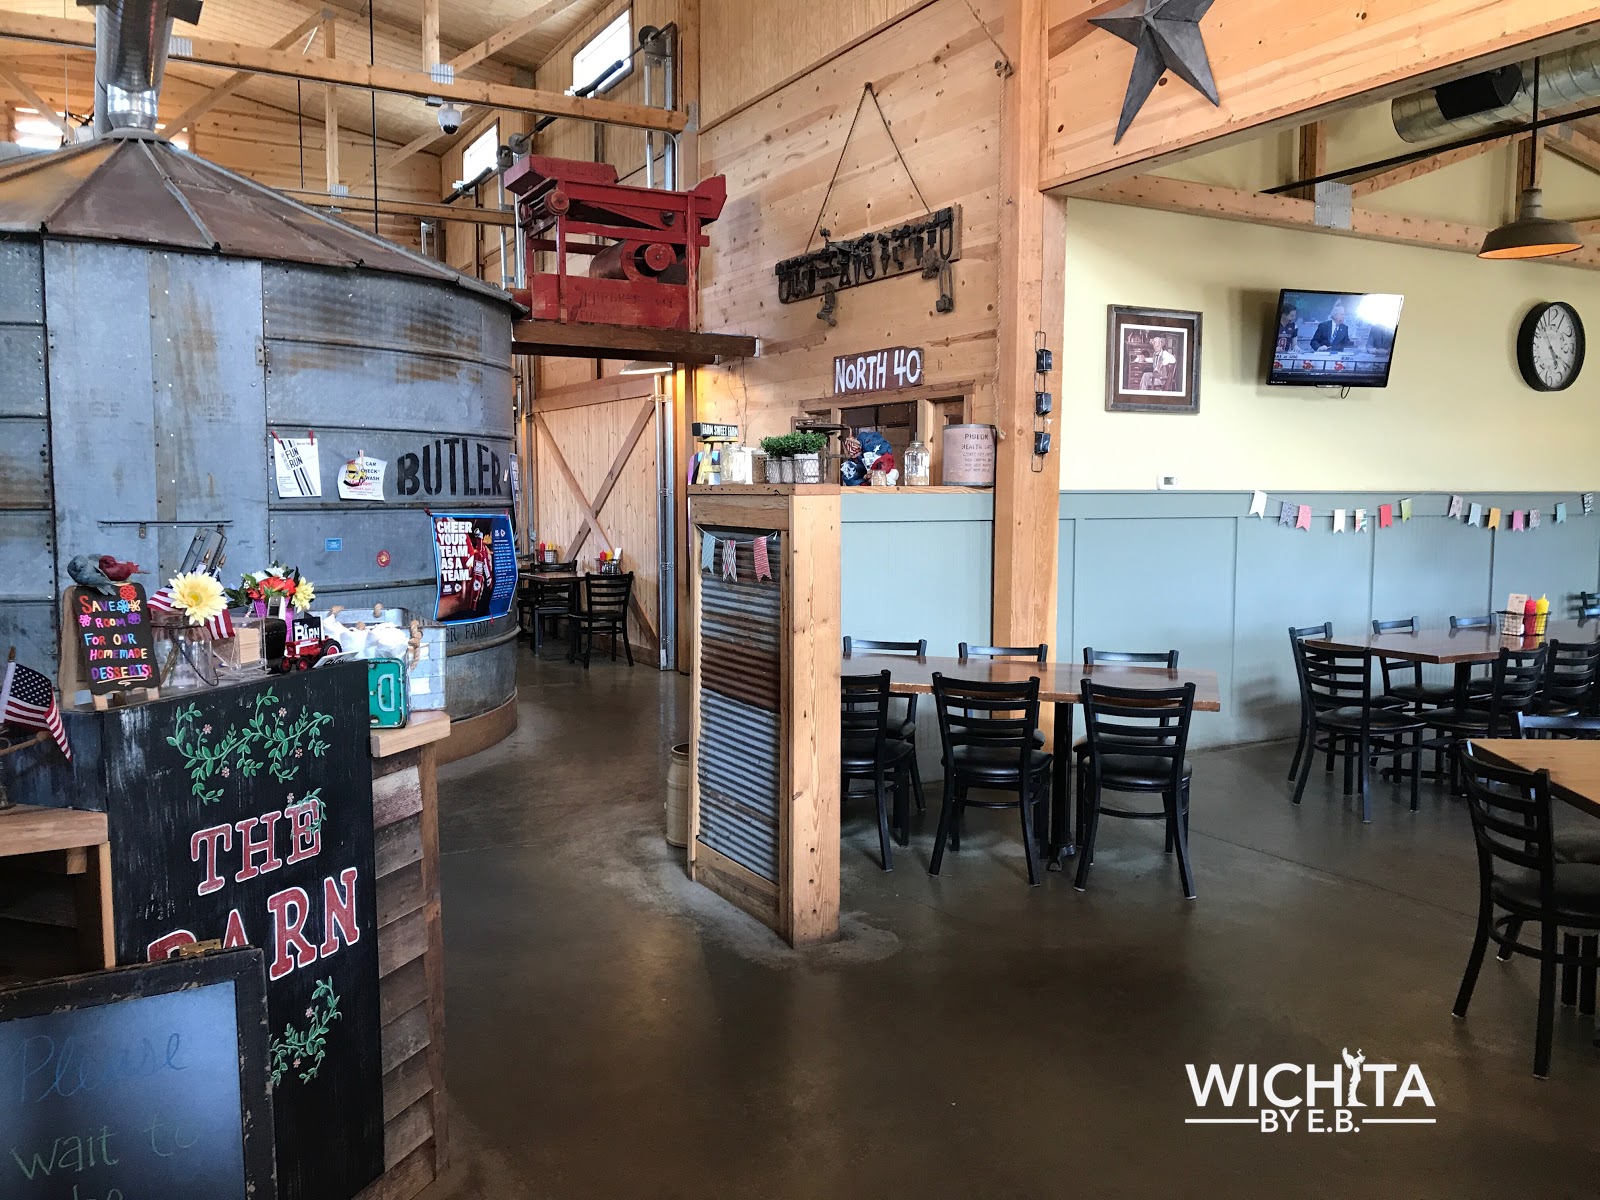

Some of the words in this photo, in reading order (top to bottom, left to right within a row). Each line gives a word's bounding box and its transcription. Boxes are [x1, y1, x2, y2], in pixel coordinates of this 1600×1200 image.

[834, 351, 888, 394] NORTH
[893, 349, 922, 386] 40
[285, 447, 299, 460] FUN
[289, 456, 303, 469] RUN
[396, 437, 502, 496] BUTLER
[437, 521, 473, 534] CHEER
[438, 533, 467, 546] YOUR
[441, 557, 454, 570] AS
[455, 557, 463, 570] A
[80, 595, 118, 614] SAVE
[84, 632, 106, 646] FOR
[113, 633, 137, 646] OUR
[294, 623, 320, 642] BARN
[190, 798, 322, 896] THE
[147, 866, 360, 981] RN
